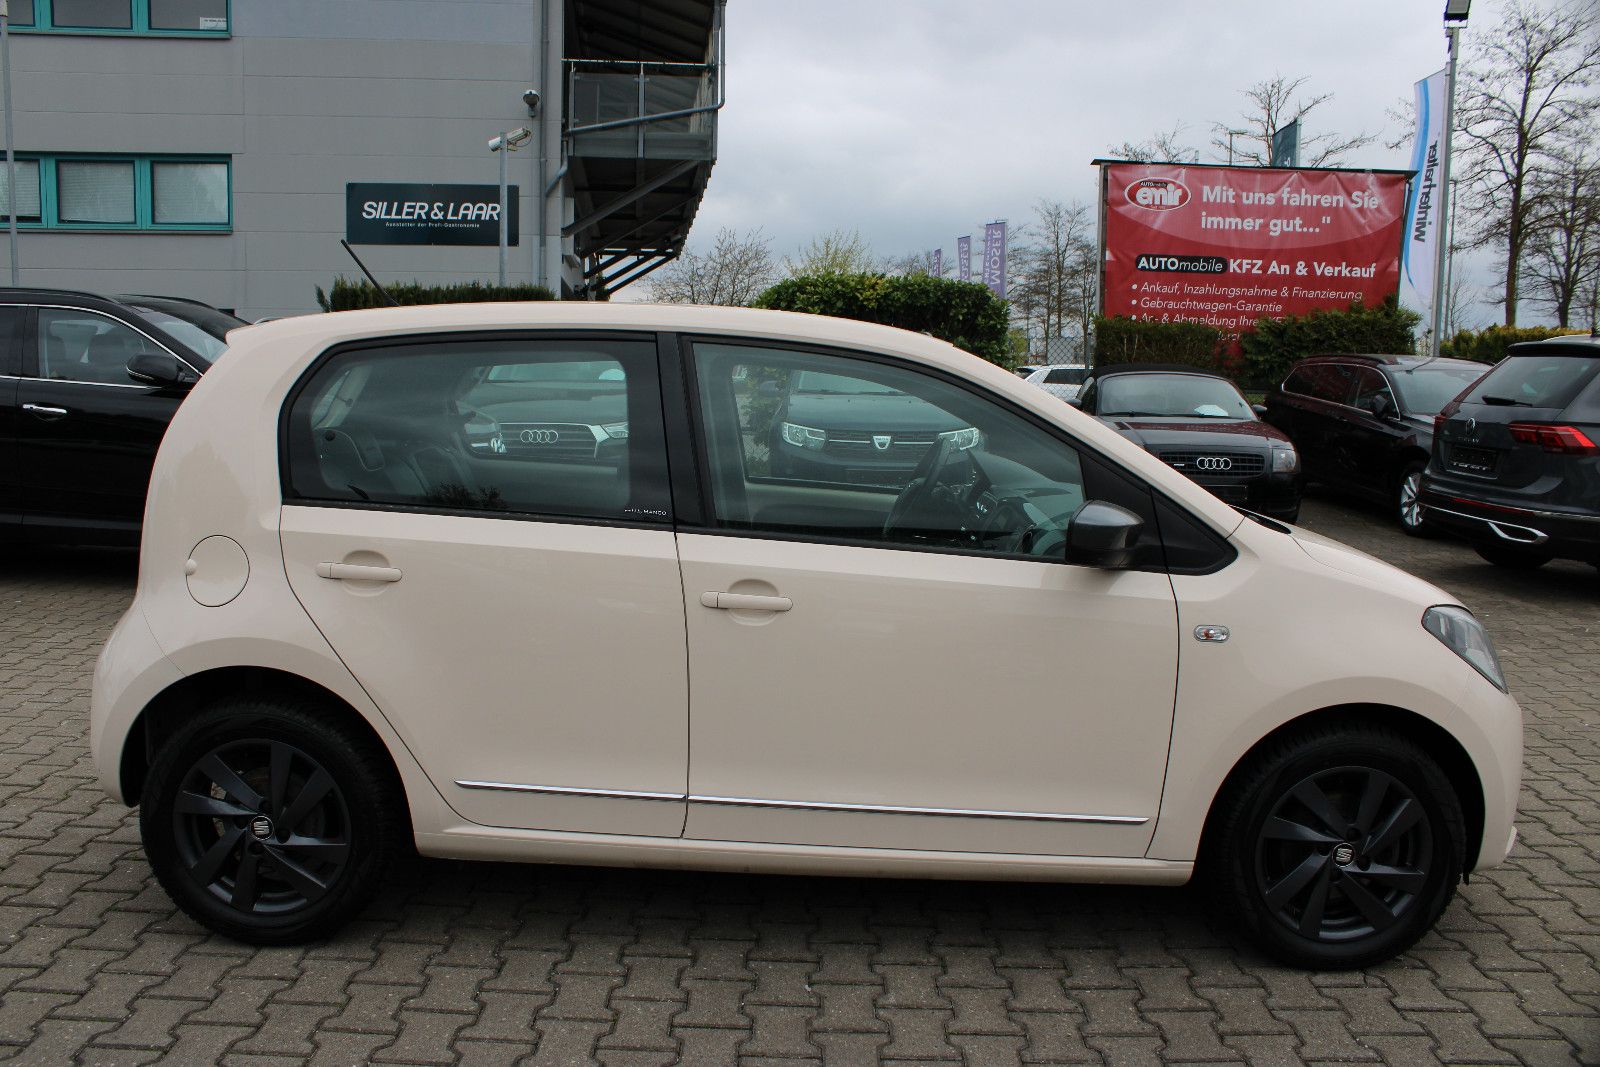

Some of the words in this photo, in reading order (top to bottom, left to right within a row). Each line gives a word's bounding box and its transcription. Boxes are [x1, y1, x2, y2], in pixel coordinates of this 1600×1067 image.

[1202, 185, 1236, 204] Mit
[1242, 191, 1275, 206] uns
[1281, 187, 1344, 208] fahren
[1350, 190, 1379, 209] Sie
[362, 201, 429, 220] SILLER
[430, 202, 444, 220] &
[447, 202, 500, 221] LAAR
[1201, 211, 1264, 230] immer
[1137, 256, 1224, 273] AUTOmobile
[1229, 259, 1263, 274] KFZ
[1267, 260, 1290, 275] An
[1295, 261, 1309, 276] &
[1313, 261, 1377, 278] Verkauf
[1140, 281, 1180, 295] Ankauf,
[1183, 283, 1278, 298] Inzahlungsnahme
[1280, 286, 1289, 297] &
[1292, 286, 1363, 302] Finanzierung
[1140, 296, 1283, 313] Gebrauchtwagen-Garantie
